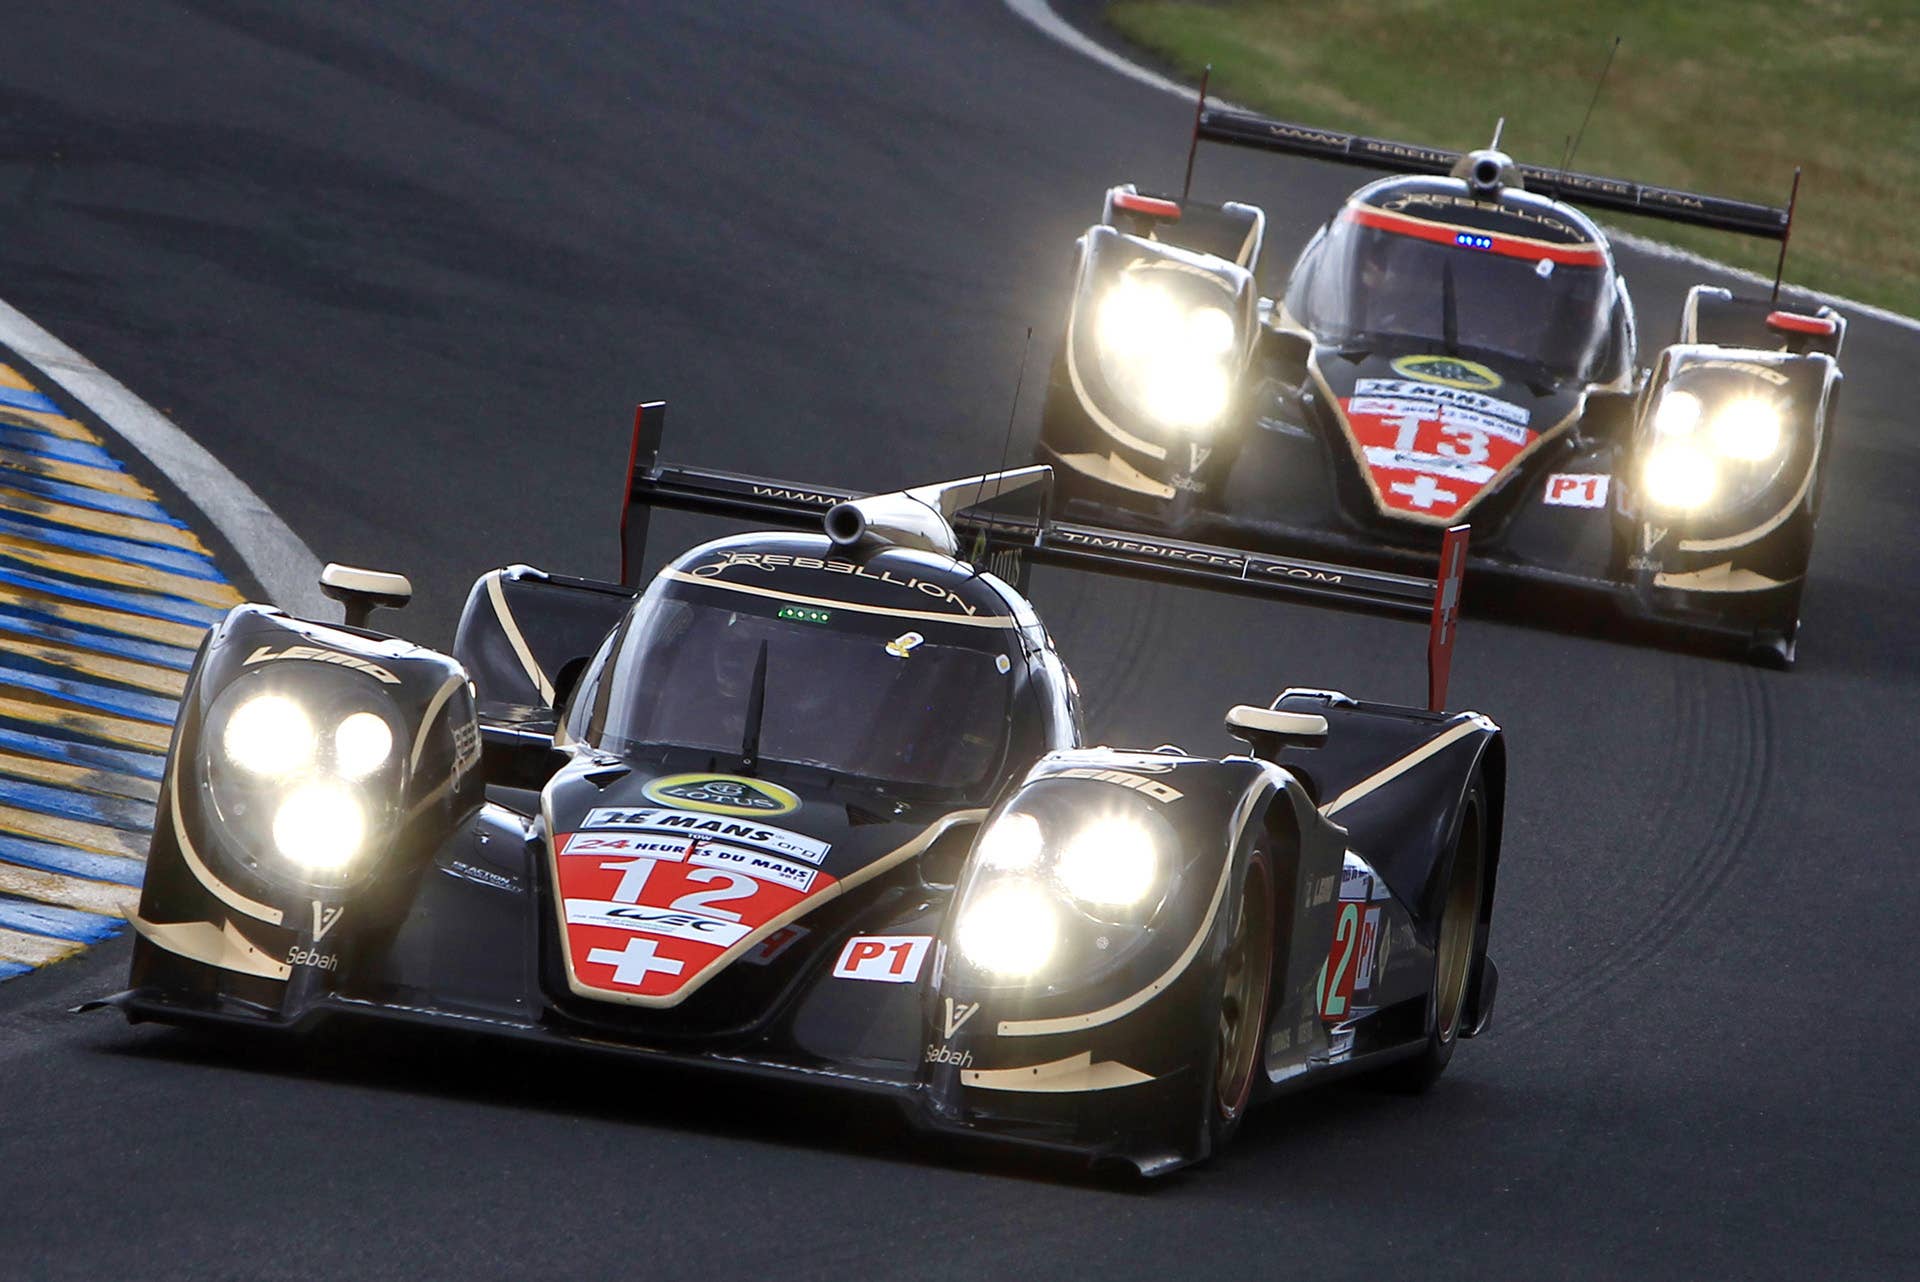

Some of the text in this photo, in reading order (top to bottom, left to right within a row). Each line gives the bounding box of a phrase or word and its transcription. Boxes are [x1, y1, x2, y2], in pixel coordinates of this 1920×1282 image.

[1380, 415, 1491, 465] 13
[1551, 479, 1596, 500] P1
[691, 551, 977, 616] REBELLION
[666, 787, 775, 808] LOTUS
[656, 815, 775, 840] MANS
[574, 838, 809, 878] 24 HEURES DU MANS
[598, 858, 743, 924] 12
[606, 907, 728, 933] WEC
[286, 945, 338, 972] Sebah
[844, 940, 917, 975] P1
[924, 1043, 973, 1069] Sebah
